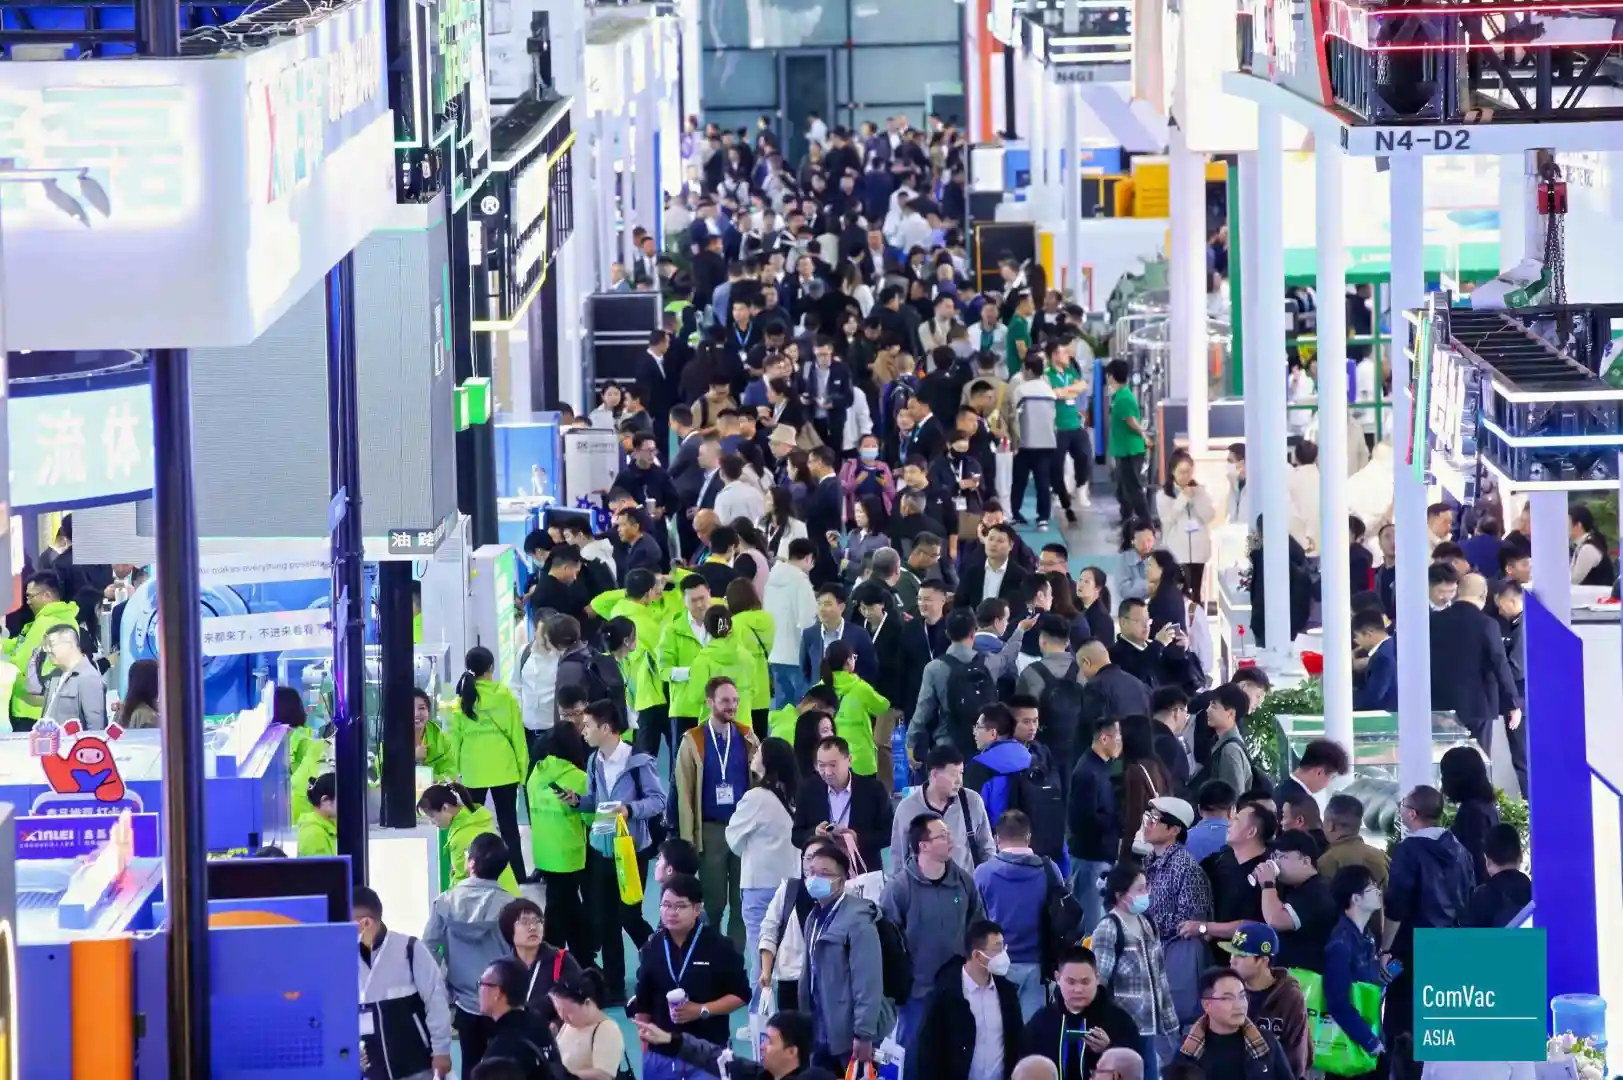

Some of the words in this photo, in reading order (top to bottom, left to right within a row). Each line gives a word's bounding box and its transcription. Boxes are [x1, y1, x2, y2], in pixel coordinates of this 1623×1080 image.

[1375, 129, 1471, 151] N4-D2
[212, 564, 241, 575] makes
[242, 562, 288, 573] everything
